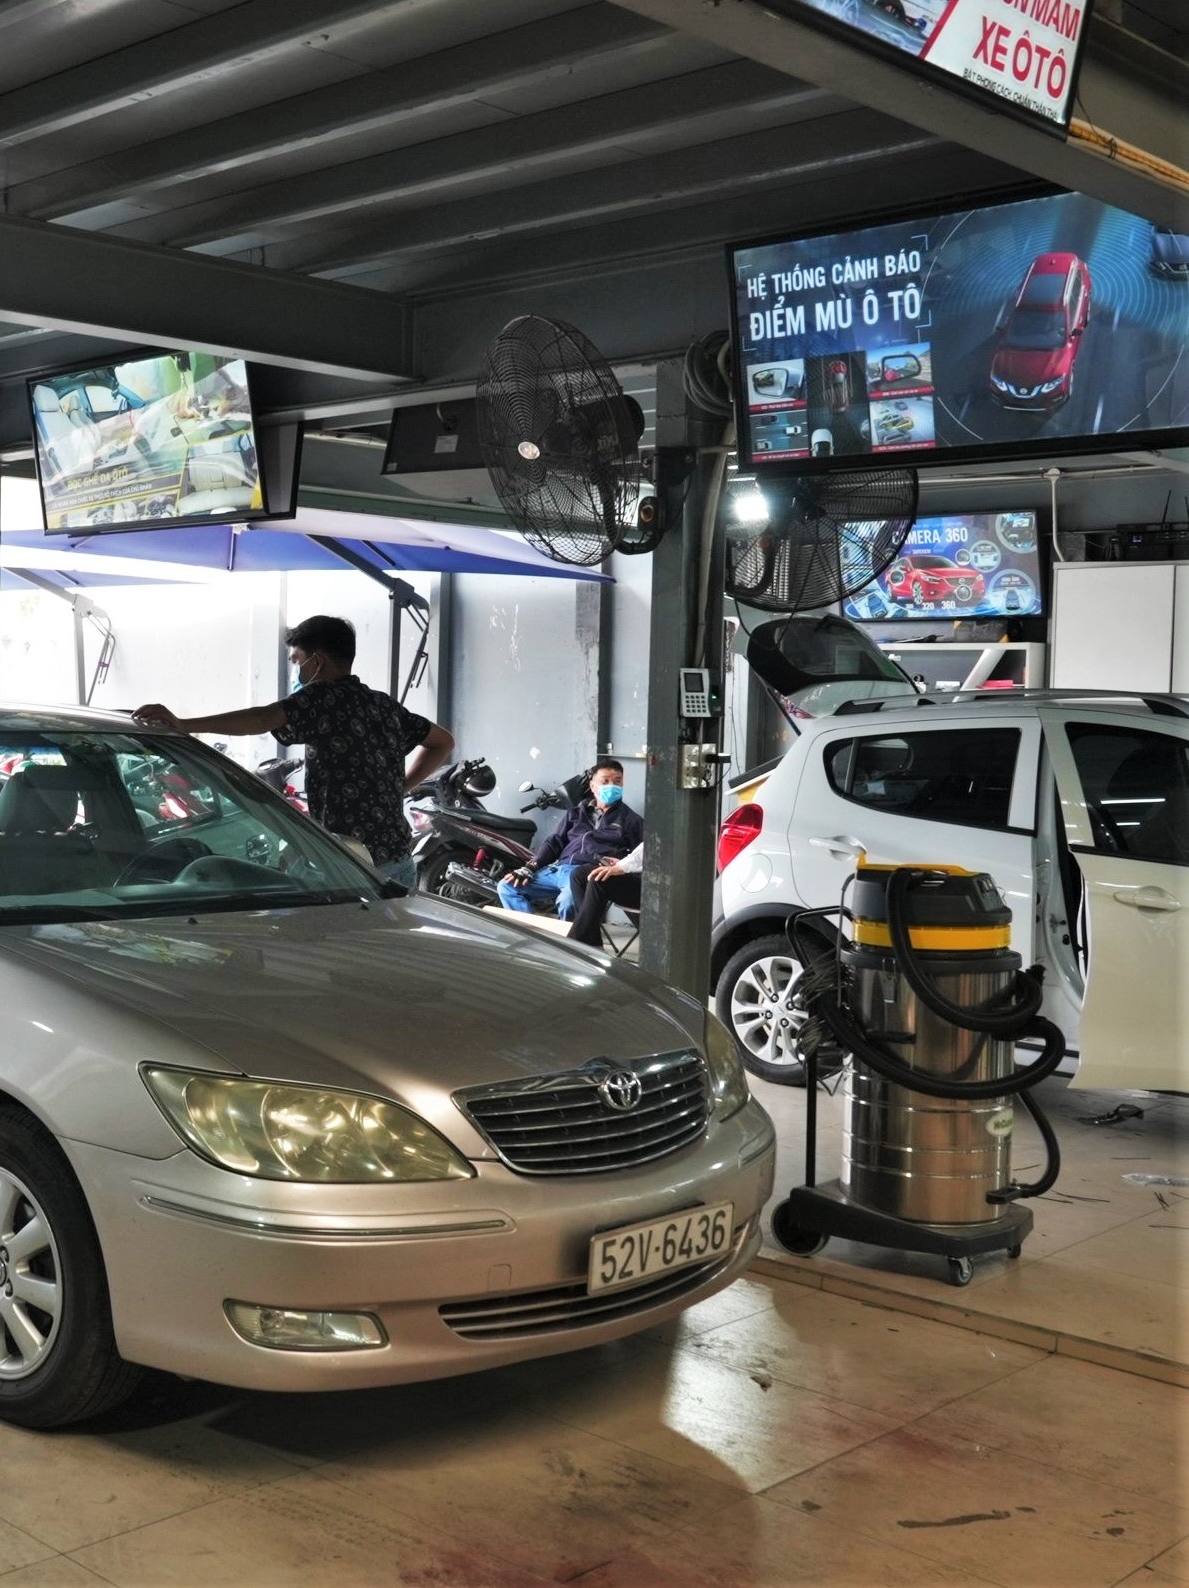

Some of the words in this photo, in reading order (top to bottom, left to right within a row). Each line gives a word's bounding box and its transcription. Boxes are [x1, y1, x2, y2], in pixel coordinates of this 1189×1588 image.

[973, 15, 1012, 72] XE
[747, 272, 767, 300] HỆ
[771, 263, 826, 295] THỐNG
[831, 255, 878, 285] CẢNH
[885, 249, 921, 276] BÁO
[749, 295, 806, 341] ĐIỂM
[815, 293, 853, 332] MÙ
[863, 288, 879, 325] Ô
[888, 282, 921, 321] TÔ
[945, 527, 968, 543] 360
[922, 602, 934, 611] 320
[941, 600, 956, 610] 360
